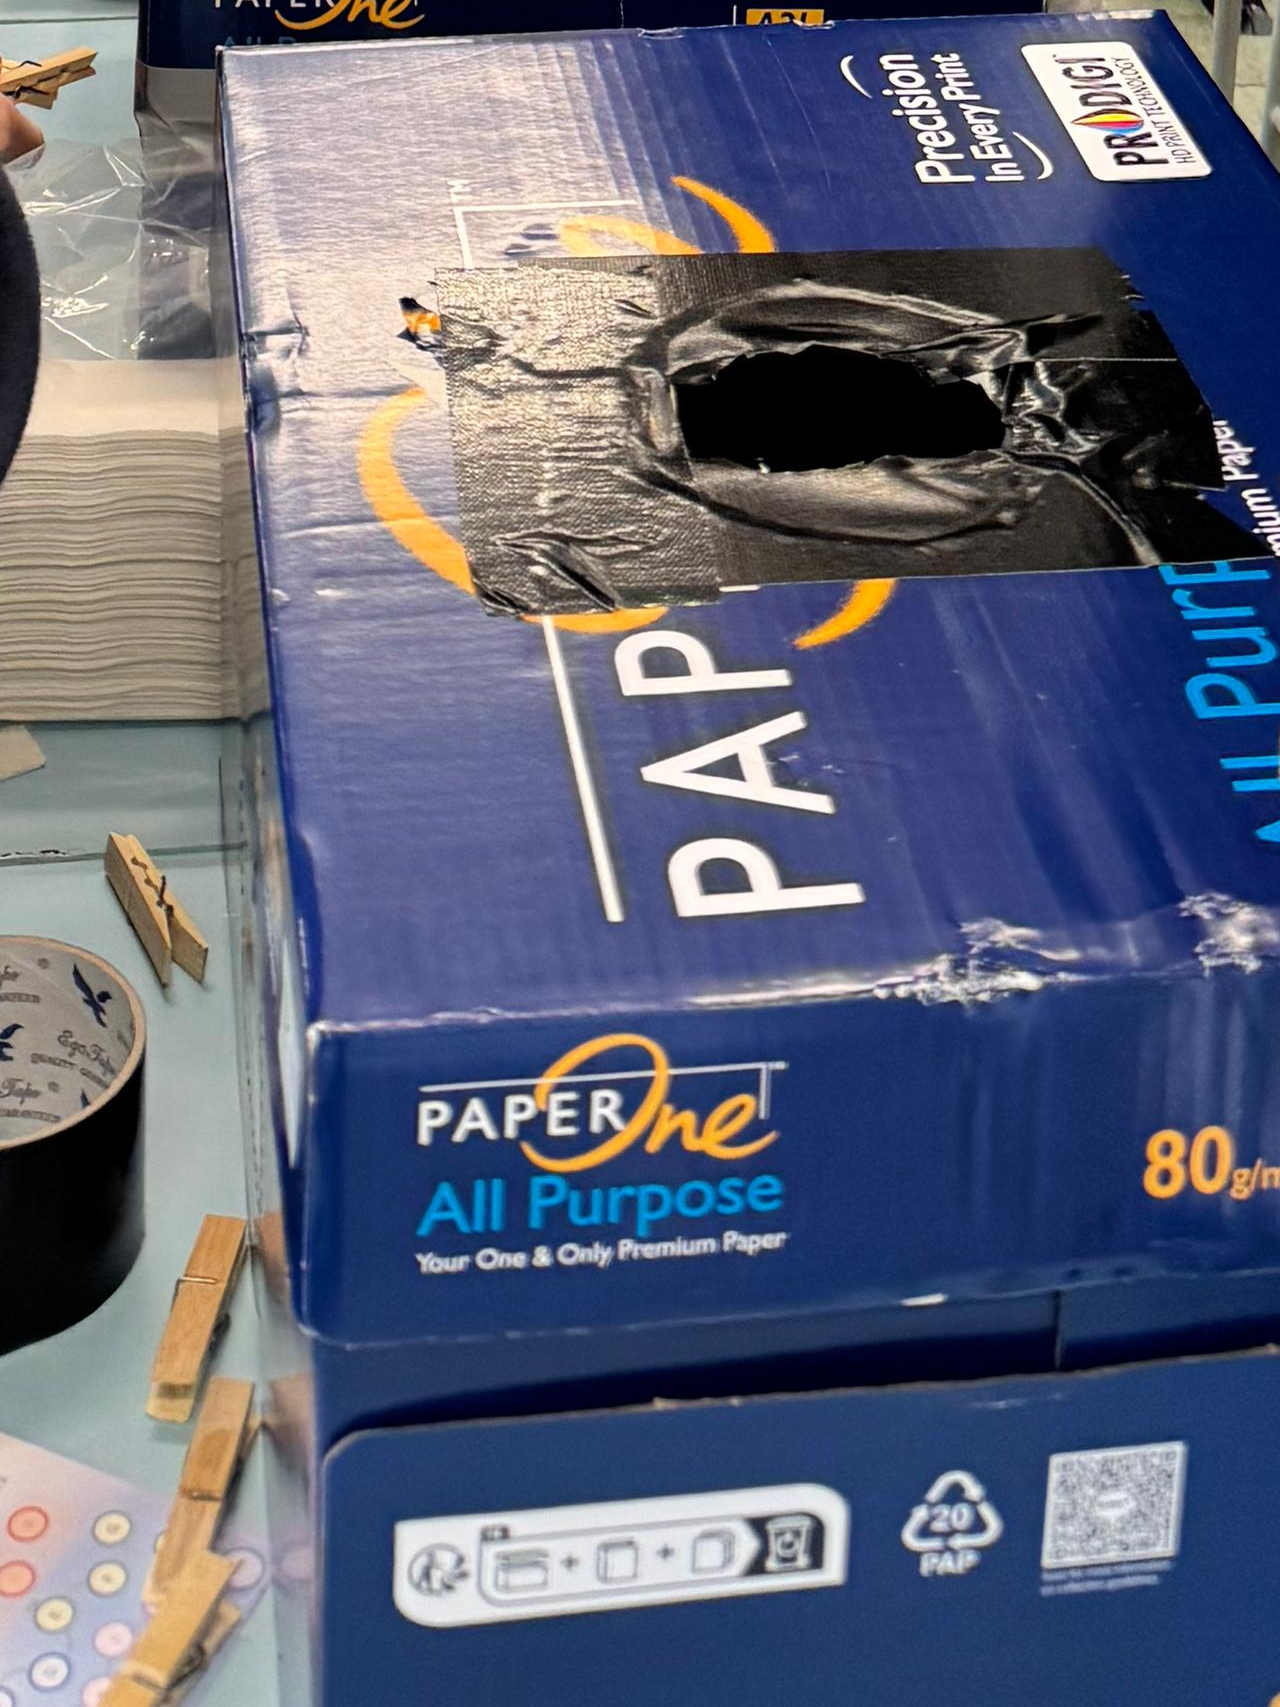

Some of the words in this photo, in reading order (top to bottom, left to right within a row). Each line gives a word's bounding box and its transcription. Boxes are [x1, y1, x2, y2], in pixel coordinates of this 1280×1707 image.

[930, 52, 981, 102] Print
[1111, 56, 1167, 117] TECHNOLOGY
[878, 53, 977, 184] Precision
[956, 103, 1013, 162] Every
[1151, 119, 1190, 148] PRINT
[984, 162, 1026, 183] In
[1166, 147, 1197, 165] HD
[416, 1177, 505, 1238] All
[528, 1173, 784, 1238] Purpose
[415, 1251, 470, 1274] Your
[475, 1246, 526, 1271] One
[531, 1244, 552, 1267] &
[556, 1241, 614, 1269] Only
[617, 1236, 717, 1262] Premium
[722, 1230, 787, 1256] Paper
[928, 1501, 974, 1533] 20
[919, 1548, 981, 1577] PAP
